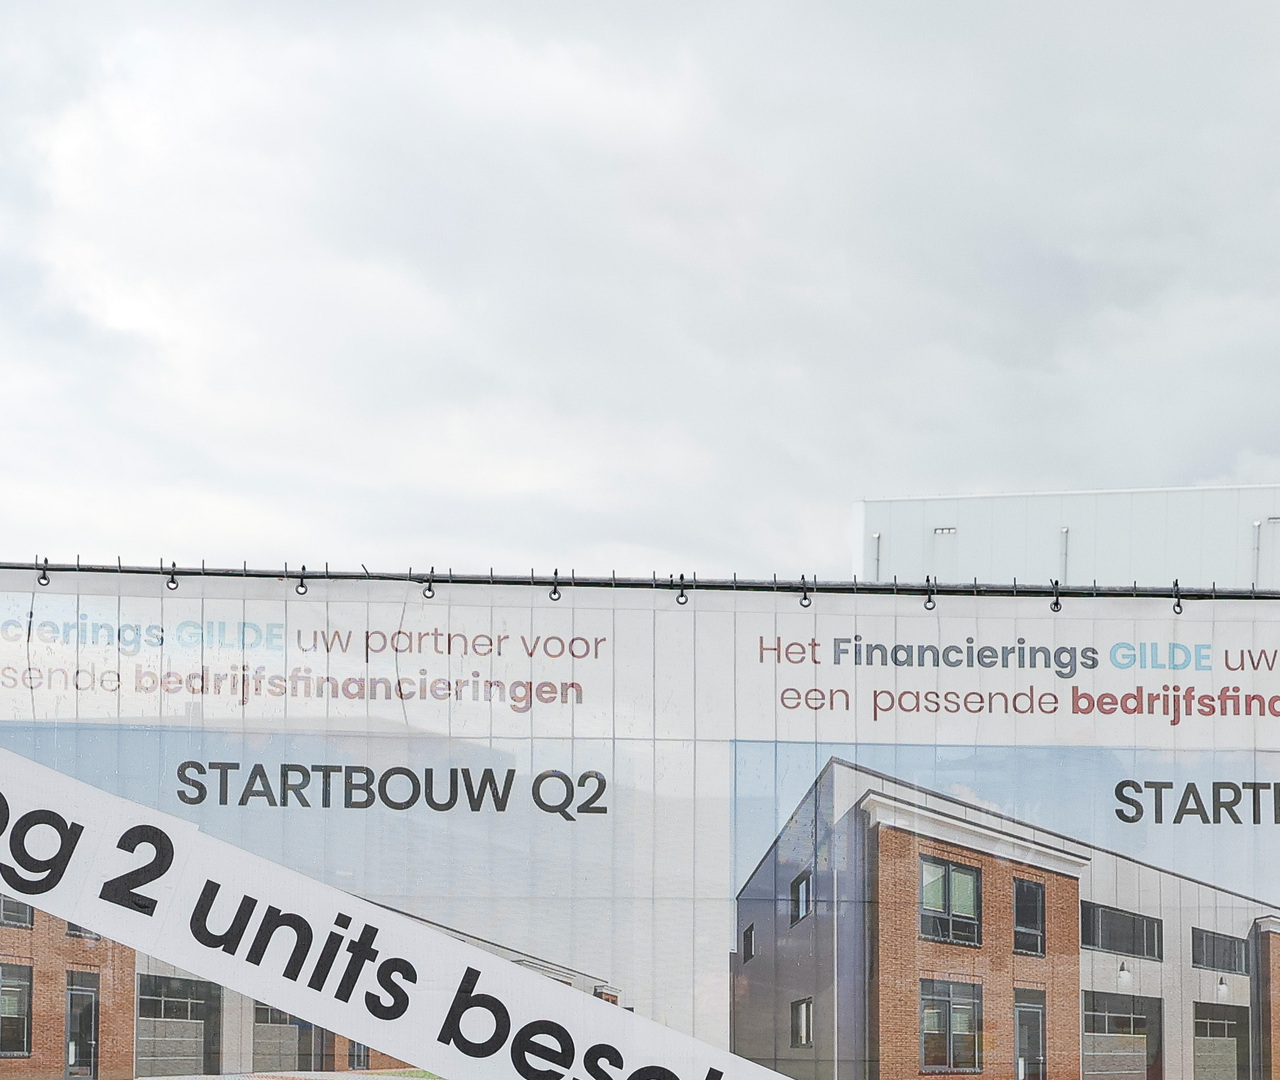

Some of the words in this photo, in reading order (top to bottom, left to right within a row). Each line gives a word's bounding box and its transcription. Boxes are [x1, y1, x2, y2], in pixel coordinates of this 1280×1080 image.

[176, 622, 285, 651] GILDE
[296, 629, 353, 653] uw
[365, 626, 510, 664] partner
[520, 634, 608, 659] voor
[759, 636, 821, 664] Het
[833, 635, 1100, 679] Financierings
[1109, 642, 1212, 672] GILDE
[1224, 650, 1279, 673] uw
[134, 663, 584, 713] bedrijfsfinancieringen
[780, 687, 850, 711] een
[873, 685, 1059, 722] passende
[176, 760, 516, 812] STARTBOUW
[531, 770, 608, 822] Q2
[99, 824, 175, 917] 2
[189, 879, 418, 1021] units
